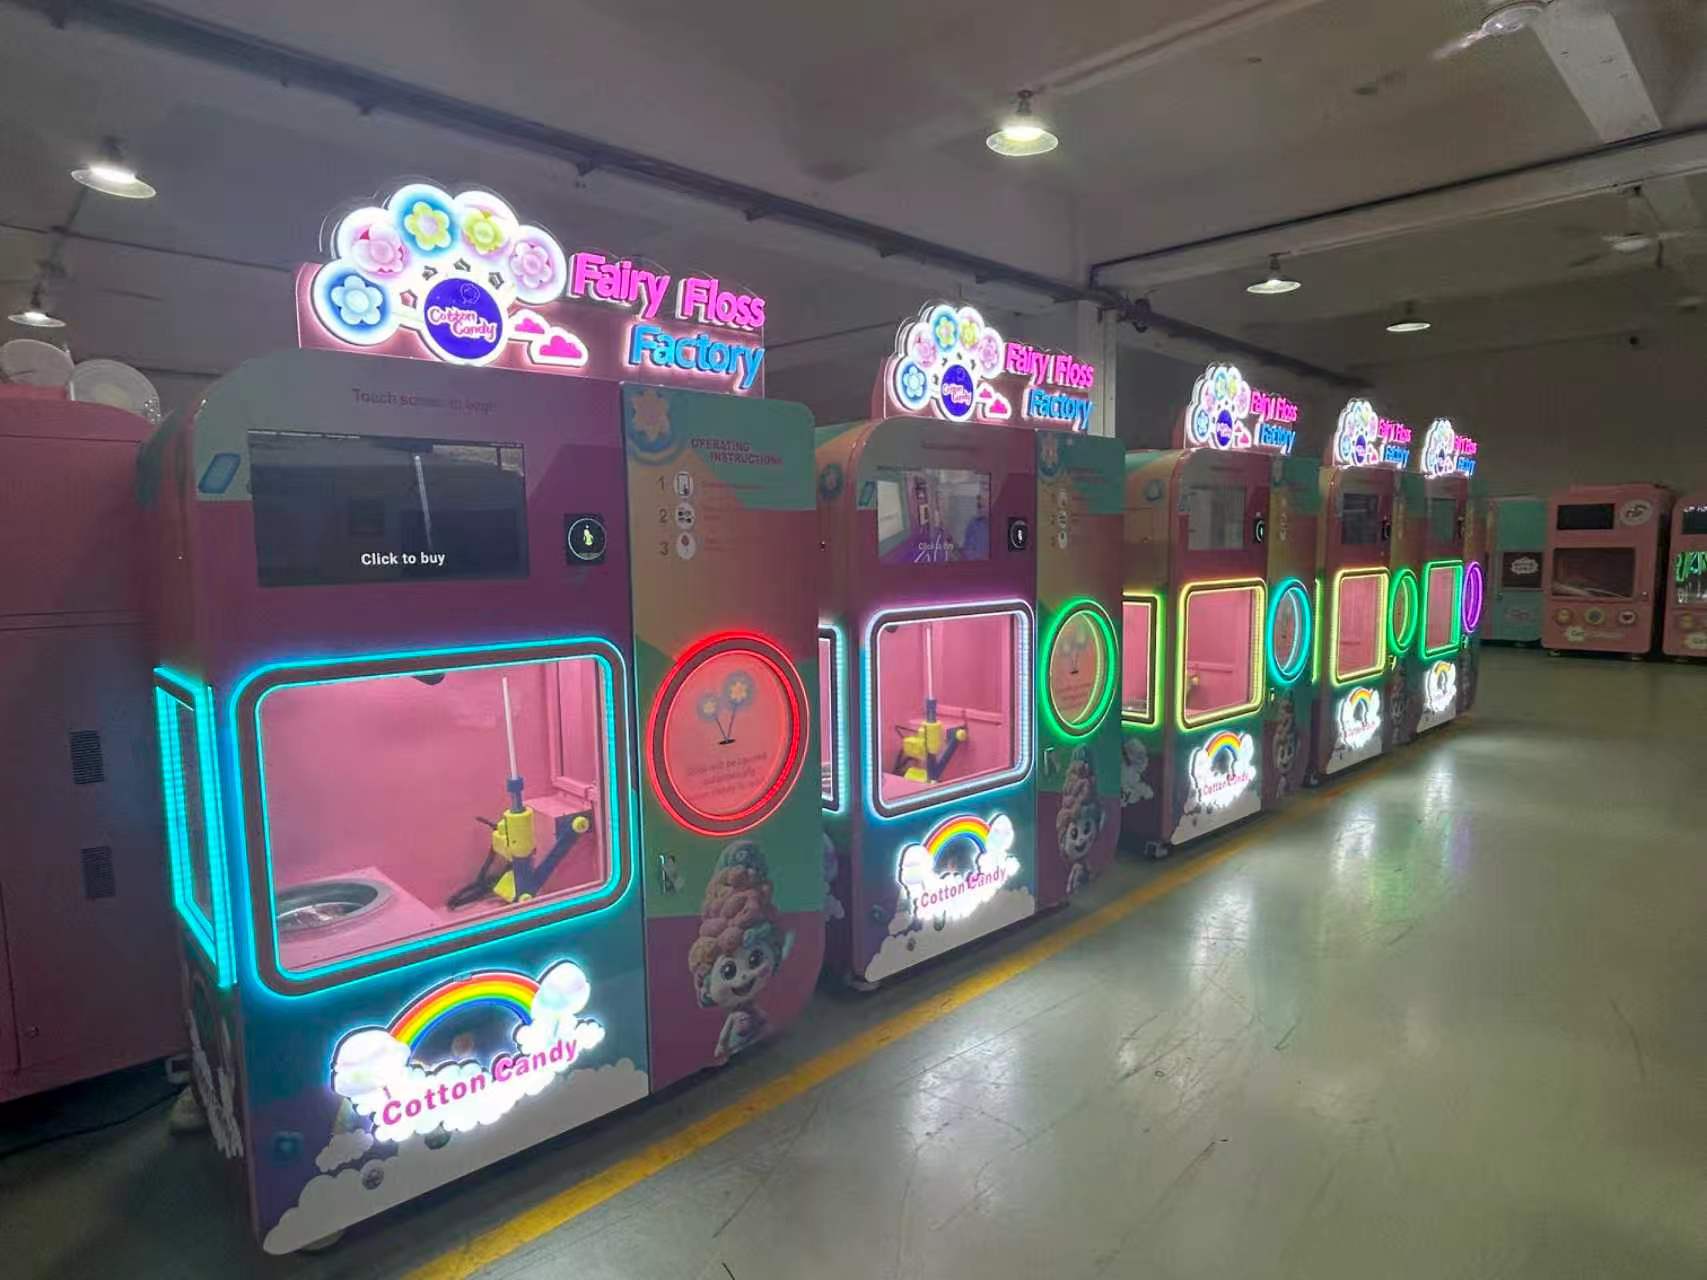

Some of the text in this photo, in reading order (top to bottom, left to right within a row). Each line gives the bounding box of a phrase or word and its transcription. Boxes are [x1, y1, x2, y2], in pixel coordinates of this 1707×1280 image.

[571, 252, 766, 328] Fairy Floss
[428, 306, 477, 325] Cotton
[450, 317, 498, 343] Candy
[628, 323, 765, 390] Factory
[1005, 341, 1095, 389] Fairy Floss
[1027, 387, 1094, 431] Factory
[691, 438, 752, 452] OPERATING
[658, 476, 665, 492] 1
[660, 507, 668, 523] 2
[360, 552, 446, 566] Click to buy
[660, 541, 669, 556] 3
[920, 865, 1006, 908] Cotton Candy
[382, 1039, 578, 1126] Cotton Candy
